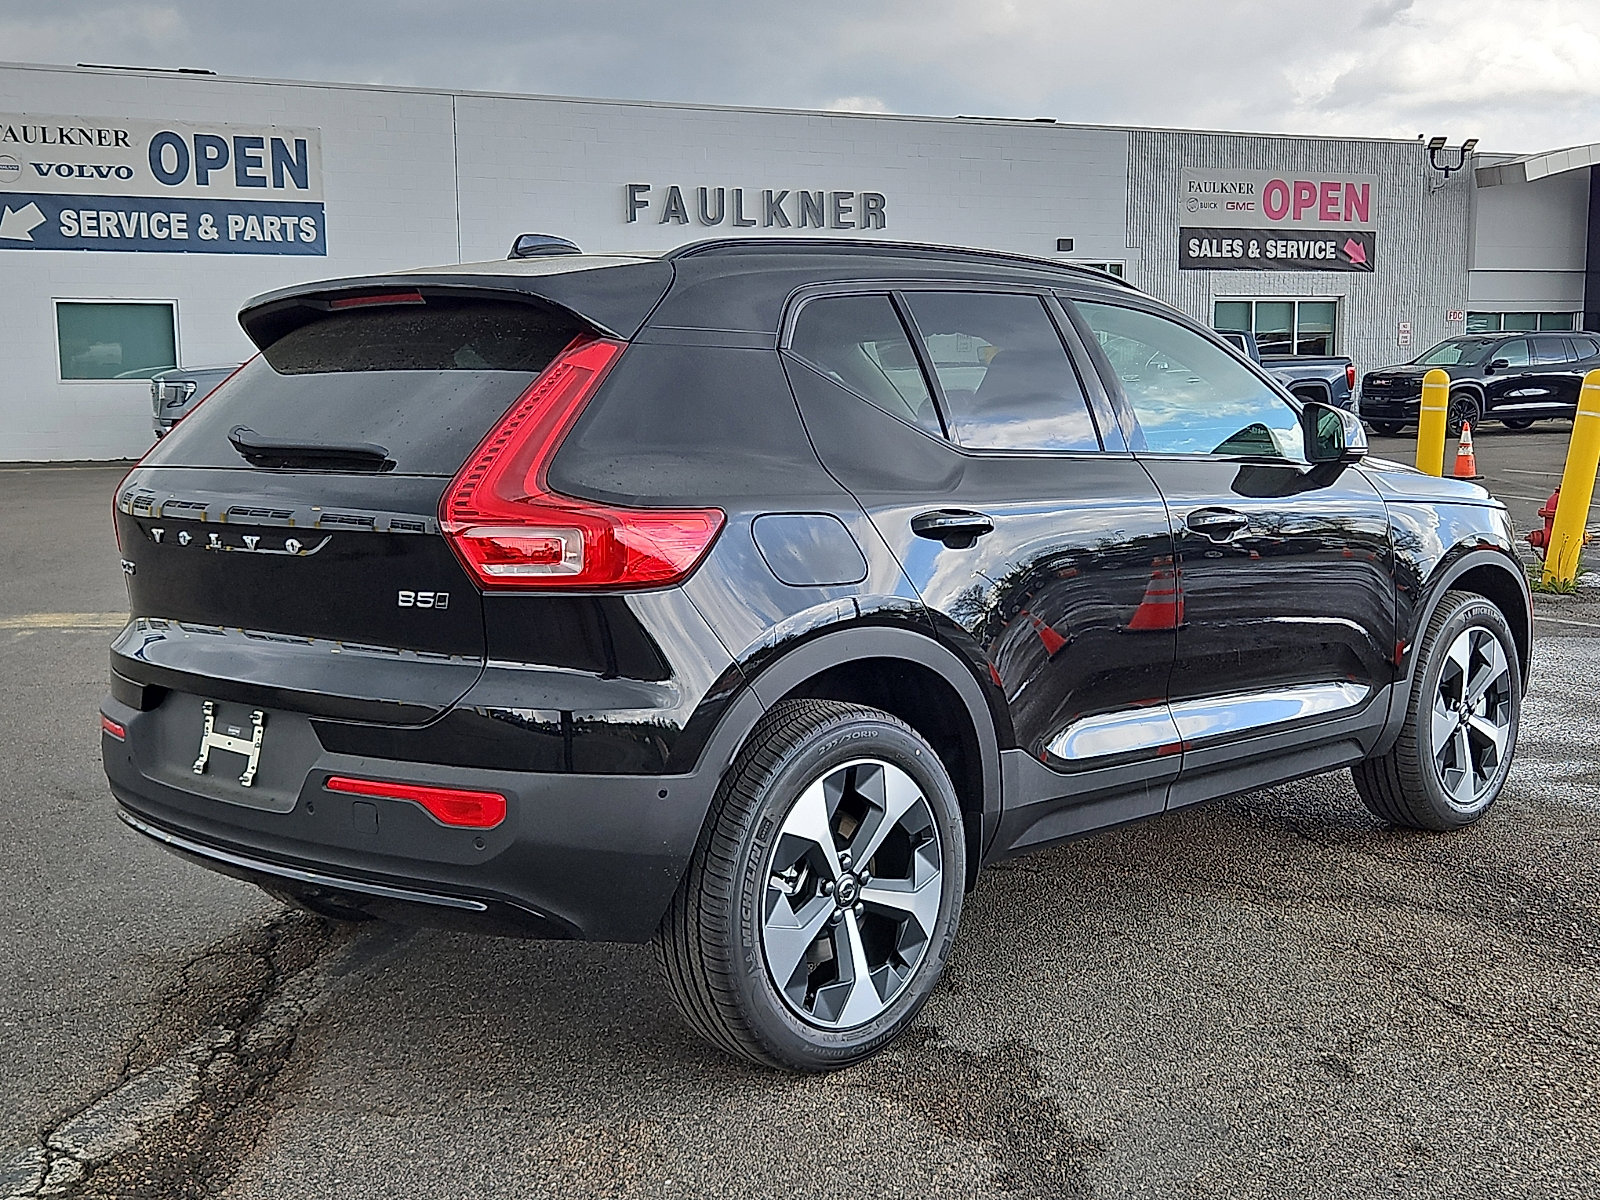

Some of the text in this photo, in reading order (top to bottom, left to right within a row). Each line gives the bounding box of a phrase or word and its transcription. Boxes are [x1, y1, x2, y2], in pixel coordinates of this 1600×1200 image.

[0, 125, 131, 147] AULKNER
[29, 162, 133, 179] VOLVO
[149, 130, 310, 189] OPEN
[1188, 181, 1254, 195] FAULKNER
[625, 184, 886, 229] FAULKNER
[1226, 202, 1255, 211] GMC
[1262, 179, 1370, 222] OPEN
[59, 209, 317, 242] SERVICE & PARTS
[1188, 238, 1336, 259] SALES & SERVICE
[1449, 311, 1463, 320] FDC
[151, 528, 303, 554] VOLVO
[741, 843, 762, 948] MICHELIN
